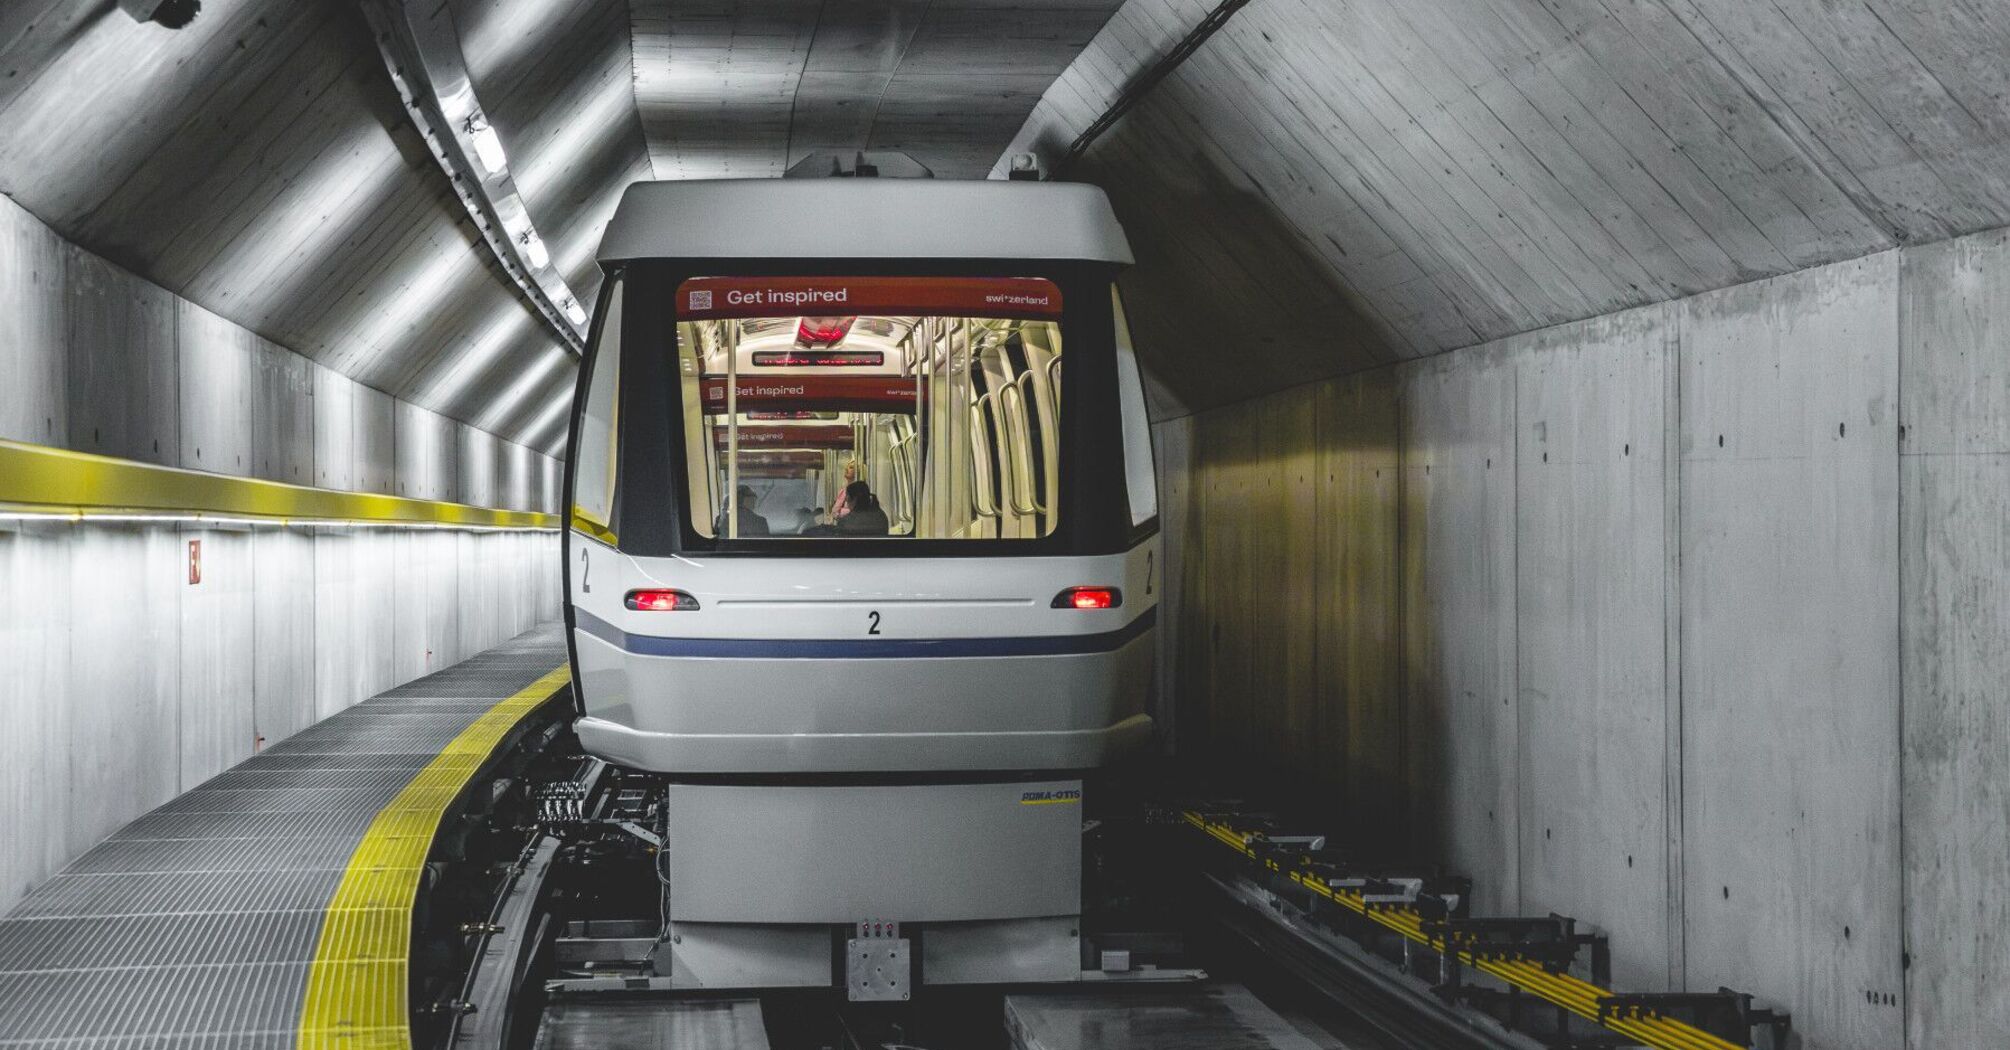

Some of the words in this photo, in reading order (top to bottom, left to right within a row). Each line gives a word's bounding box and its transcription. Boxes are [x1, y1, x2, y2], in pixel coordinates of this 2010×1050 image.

[727, 290, 763, 304] Get
[768, 288, 847, 306] inspired
[756, 385, 804, 397] inspired
[582, 547, 590, 593] 2
[1146, 550, 1153, 595] 2
[868, 610, 881, 635] 2
